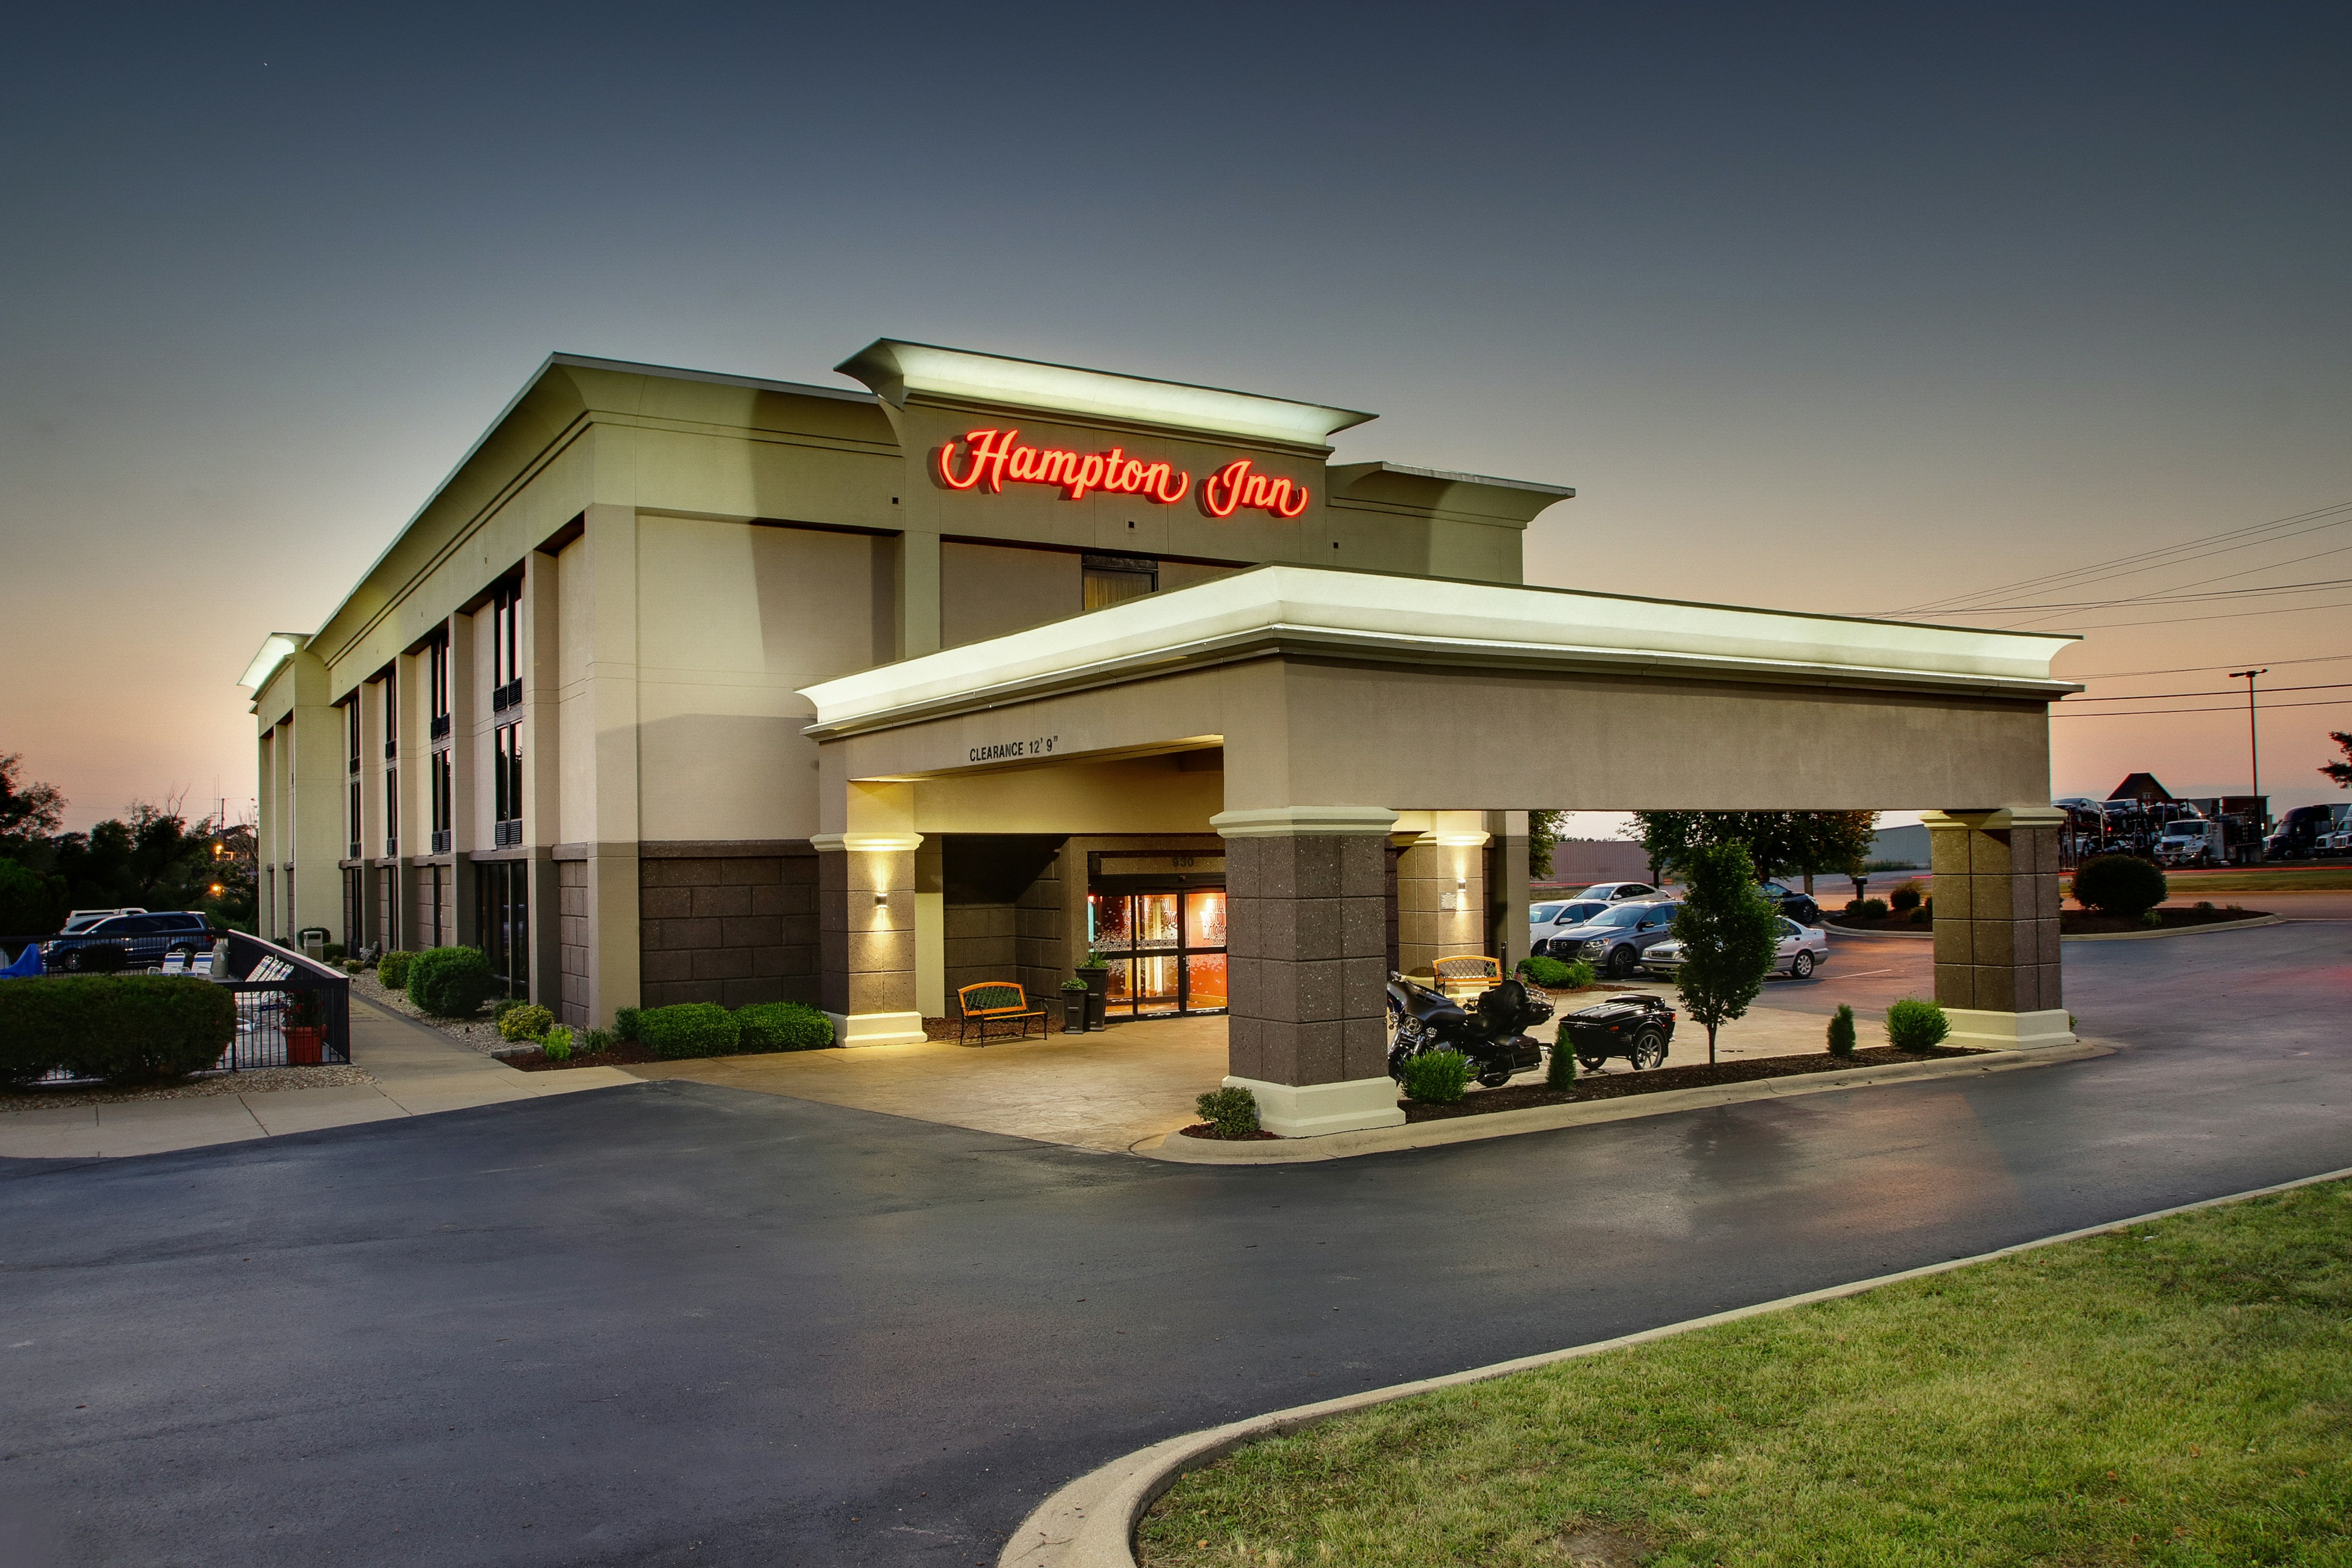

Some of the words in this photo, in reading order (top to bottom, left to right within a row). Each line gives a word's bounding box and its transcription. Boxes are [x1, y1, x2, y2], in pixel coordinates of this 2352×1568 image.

[942, 429, 1190, 503] Hampton
[1204, 460, 1309, 517] Inn
[970, 741, 1024, 762] CLEARANCE
[1029, 737, 1043, 754] 12'
[1203, 925, 1227, 940] MAK
